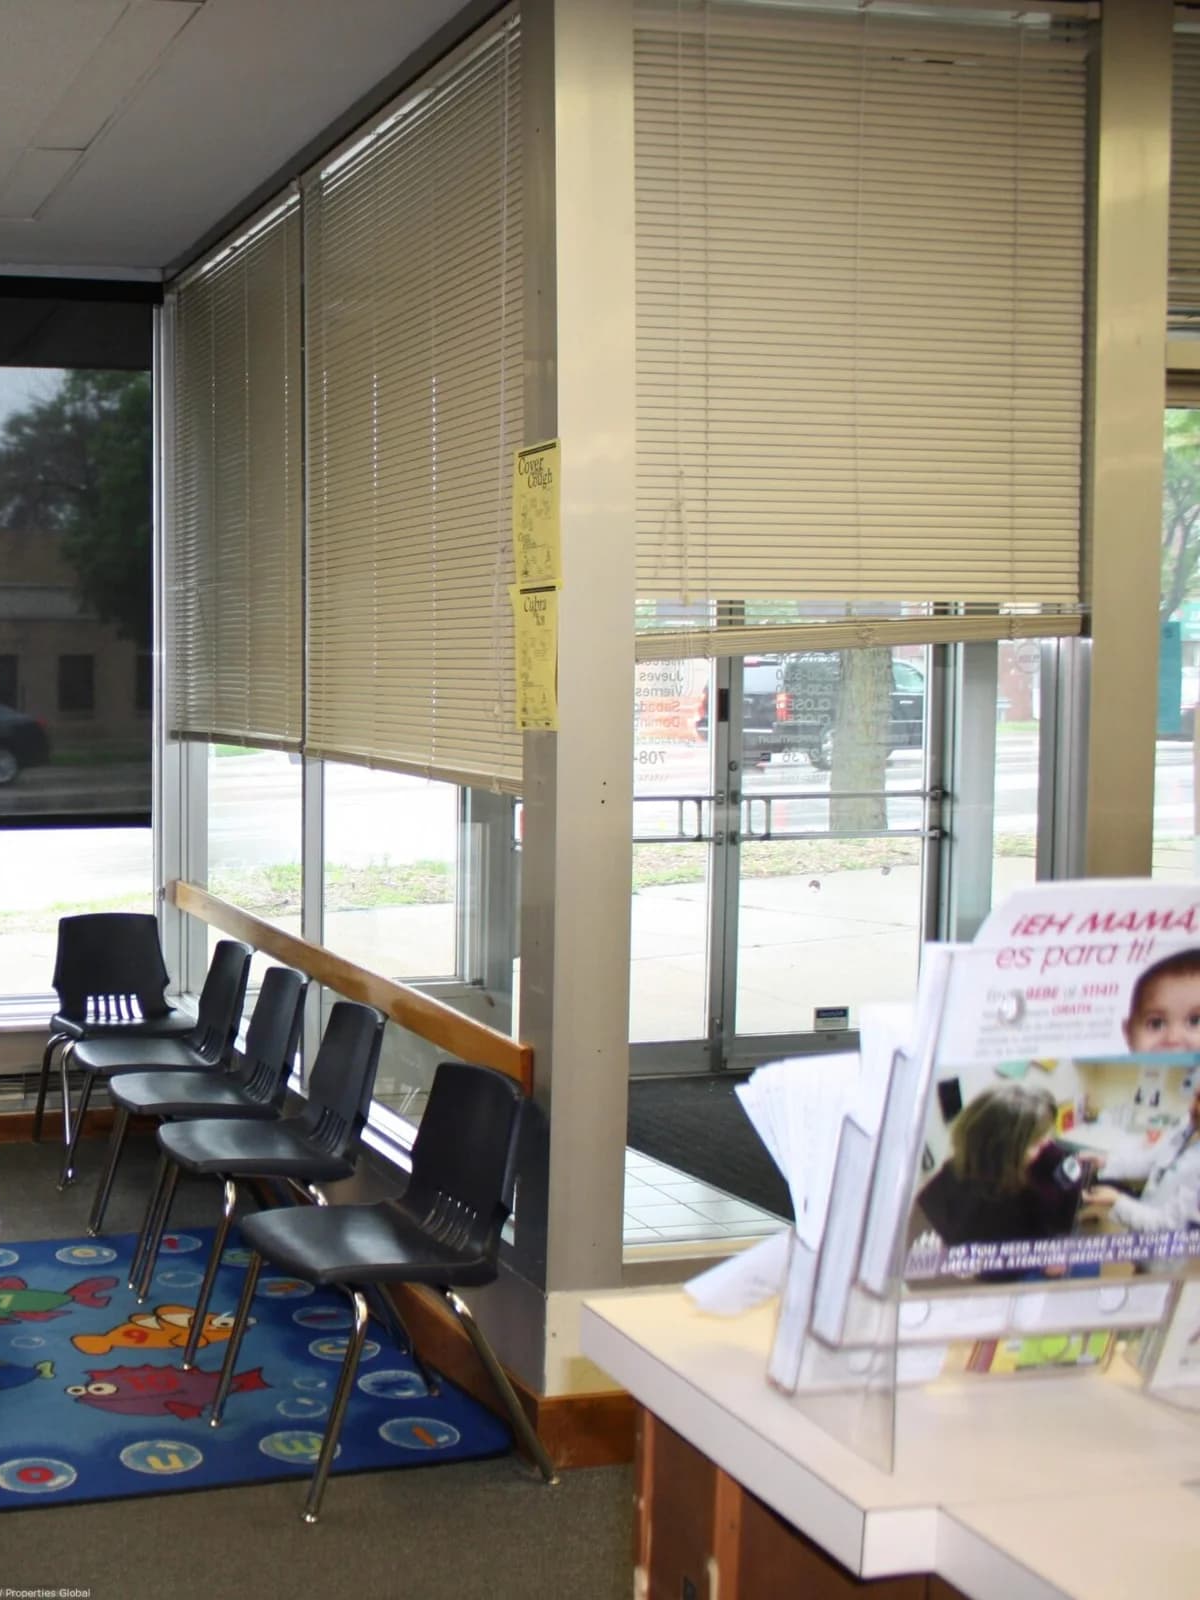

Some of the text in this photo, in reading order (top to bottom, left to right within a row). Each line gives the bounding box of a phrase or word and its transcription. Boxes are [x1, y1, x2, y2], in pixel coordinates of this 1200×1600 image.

[518, 457, 544, 476] Cover
[527, 467, 553, 490] Cough
[995, 945, 1034, 970] es
[1039, 942, 1119, 976] para
[1000, 1241, 1030, 1255] NEED
[122, 1329, 148, 1344] 9
